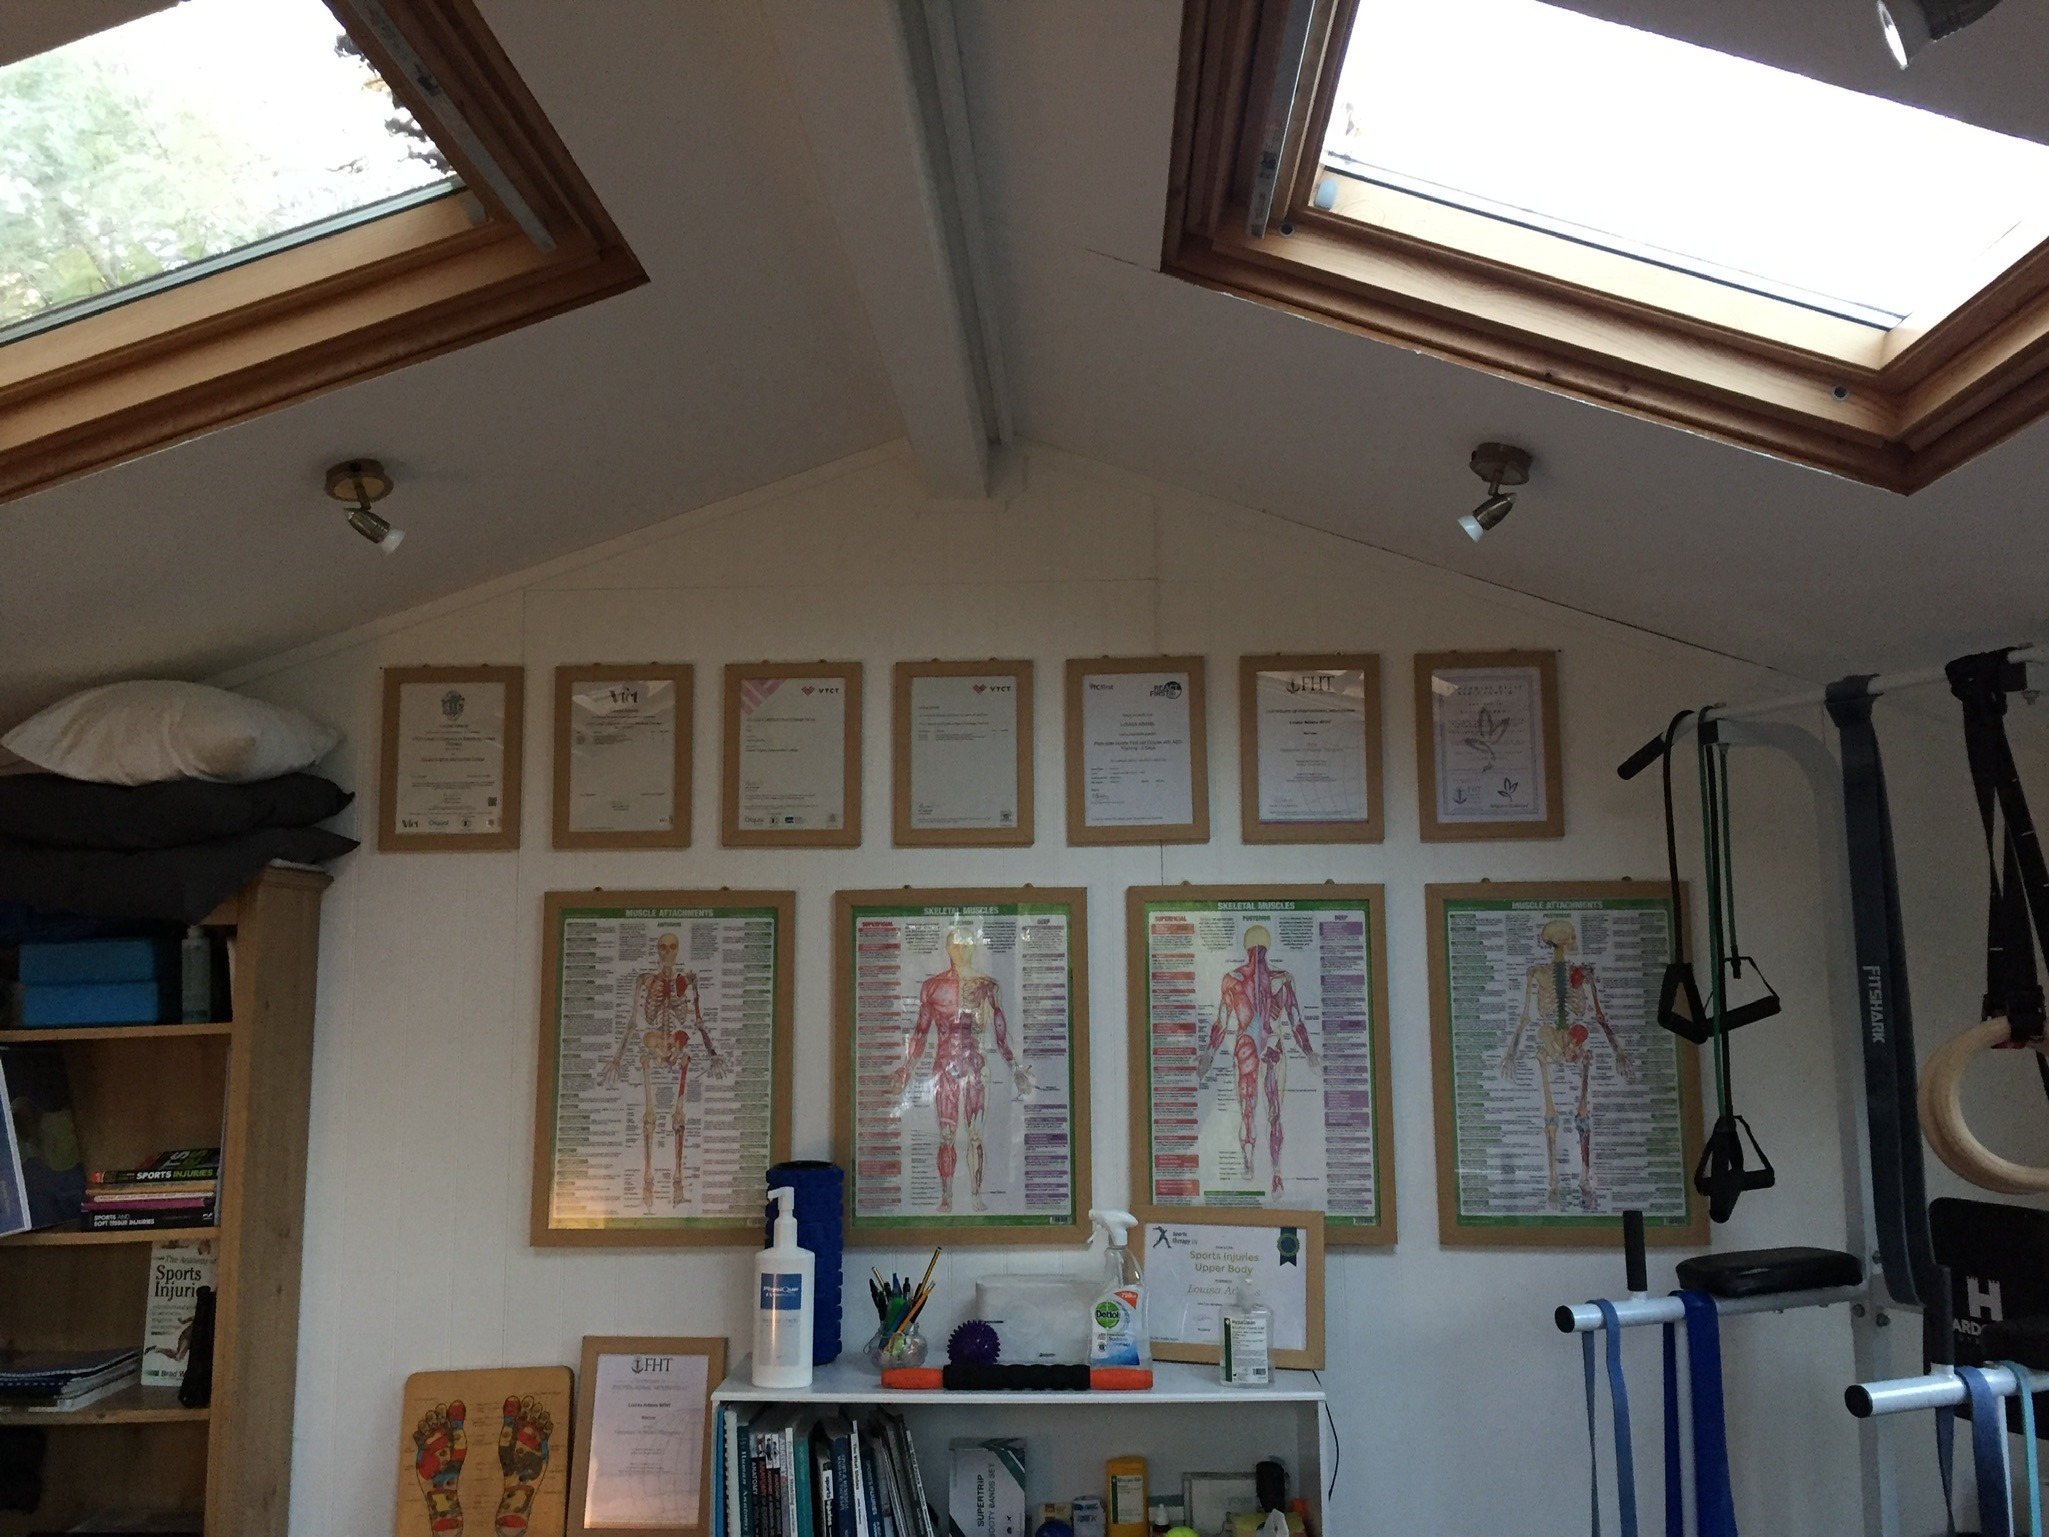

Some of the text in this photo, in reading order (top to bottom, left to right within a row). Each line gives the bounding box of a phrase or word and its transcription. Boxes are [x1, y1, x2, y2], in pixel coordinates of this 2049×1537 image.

[989, 685, 1011, 693] VTCT
[1301, 675, 1335, 692] FHT
[819, 687, 839, 695] VTCT
[923, 906, 999, 915] SKELETAL MUSCLES
[1218, 902, 1295, 910] SKELETAL MUSCLES
[1512, 901, 1604, 909] MUSCLE ATTACHMENTS
[626, 909, 714, 917] MUSCLE ATTACHMENTS
[1862, 965, 1886, 1044] FITSHARK
[136, 1168, 213, 1181] SPORTS INJURIES
[1189, 1250, 1260, 1263] Sports Injuries
[155, 1264, 202, 1285] Sports
[1195, 1262, 1254, 1276] Upper Body
[154, 1281, 196, 1302] Injuri
[1188, 1284, 1221, 1295] Louisa
[1966, 1275, 2004, 1322] H
[1096, 1309, 1119, 1319] Dettol
[644, 1357, 673, 1373] FHT
[779, 1438, 787, 1477] ANATOMY
[869, 1485, 878, 1516] INJURIES
[976, 1474, 985, 1527] SUPERTRIP
[988, 1481, 996, 1509] BANDS
